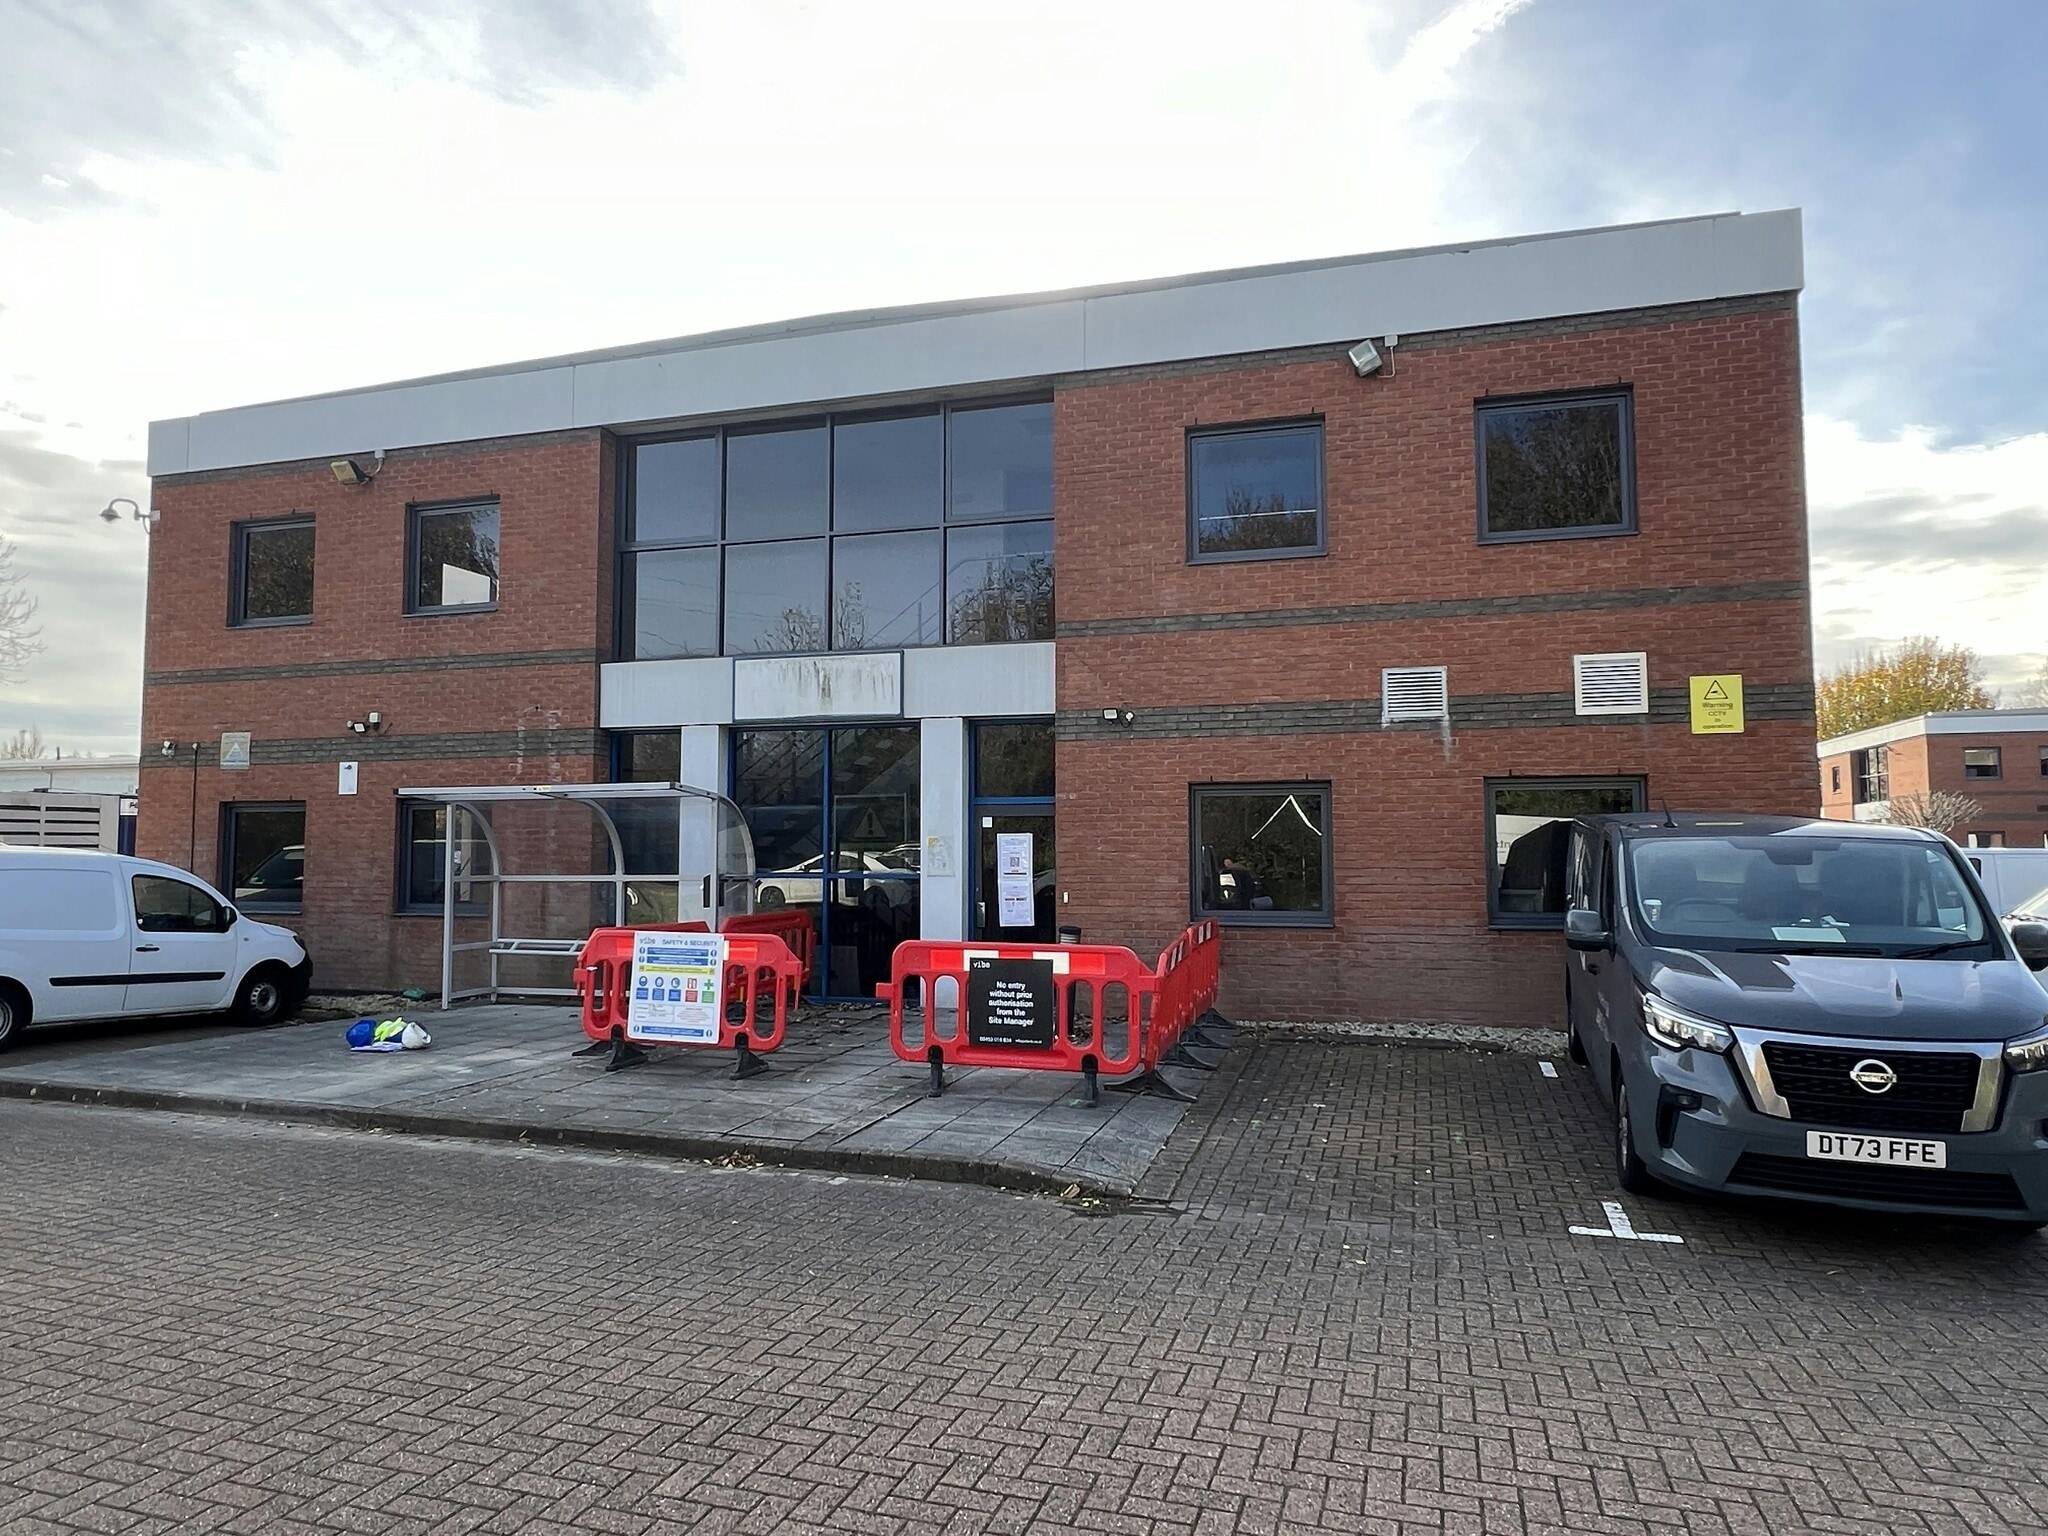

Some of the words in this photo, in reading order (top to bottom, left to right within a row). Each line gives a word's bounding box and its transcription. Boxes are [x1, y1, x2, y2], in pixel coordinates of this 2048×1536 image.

[1702, 702, 1733, 710] Warning
[996, 981, 1006, 989] No
[1008, 982, 1026, 991] entry
[989, 990, 1015, 998] without
[1016, 991, 1033, 1000] prior
[988, 999, 1034, 1008] authorisation
[996, 1007, 1013, 1015] from
[1014, 1008, 1026, 1016] the
[988, 1016, 1002, 1024] Site
[1004, 1017, 1034, 1027] Manager
[1819, 1135, 1881, 1158] DT73
[1889, 1141, 1936, 1163] FFE
